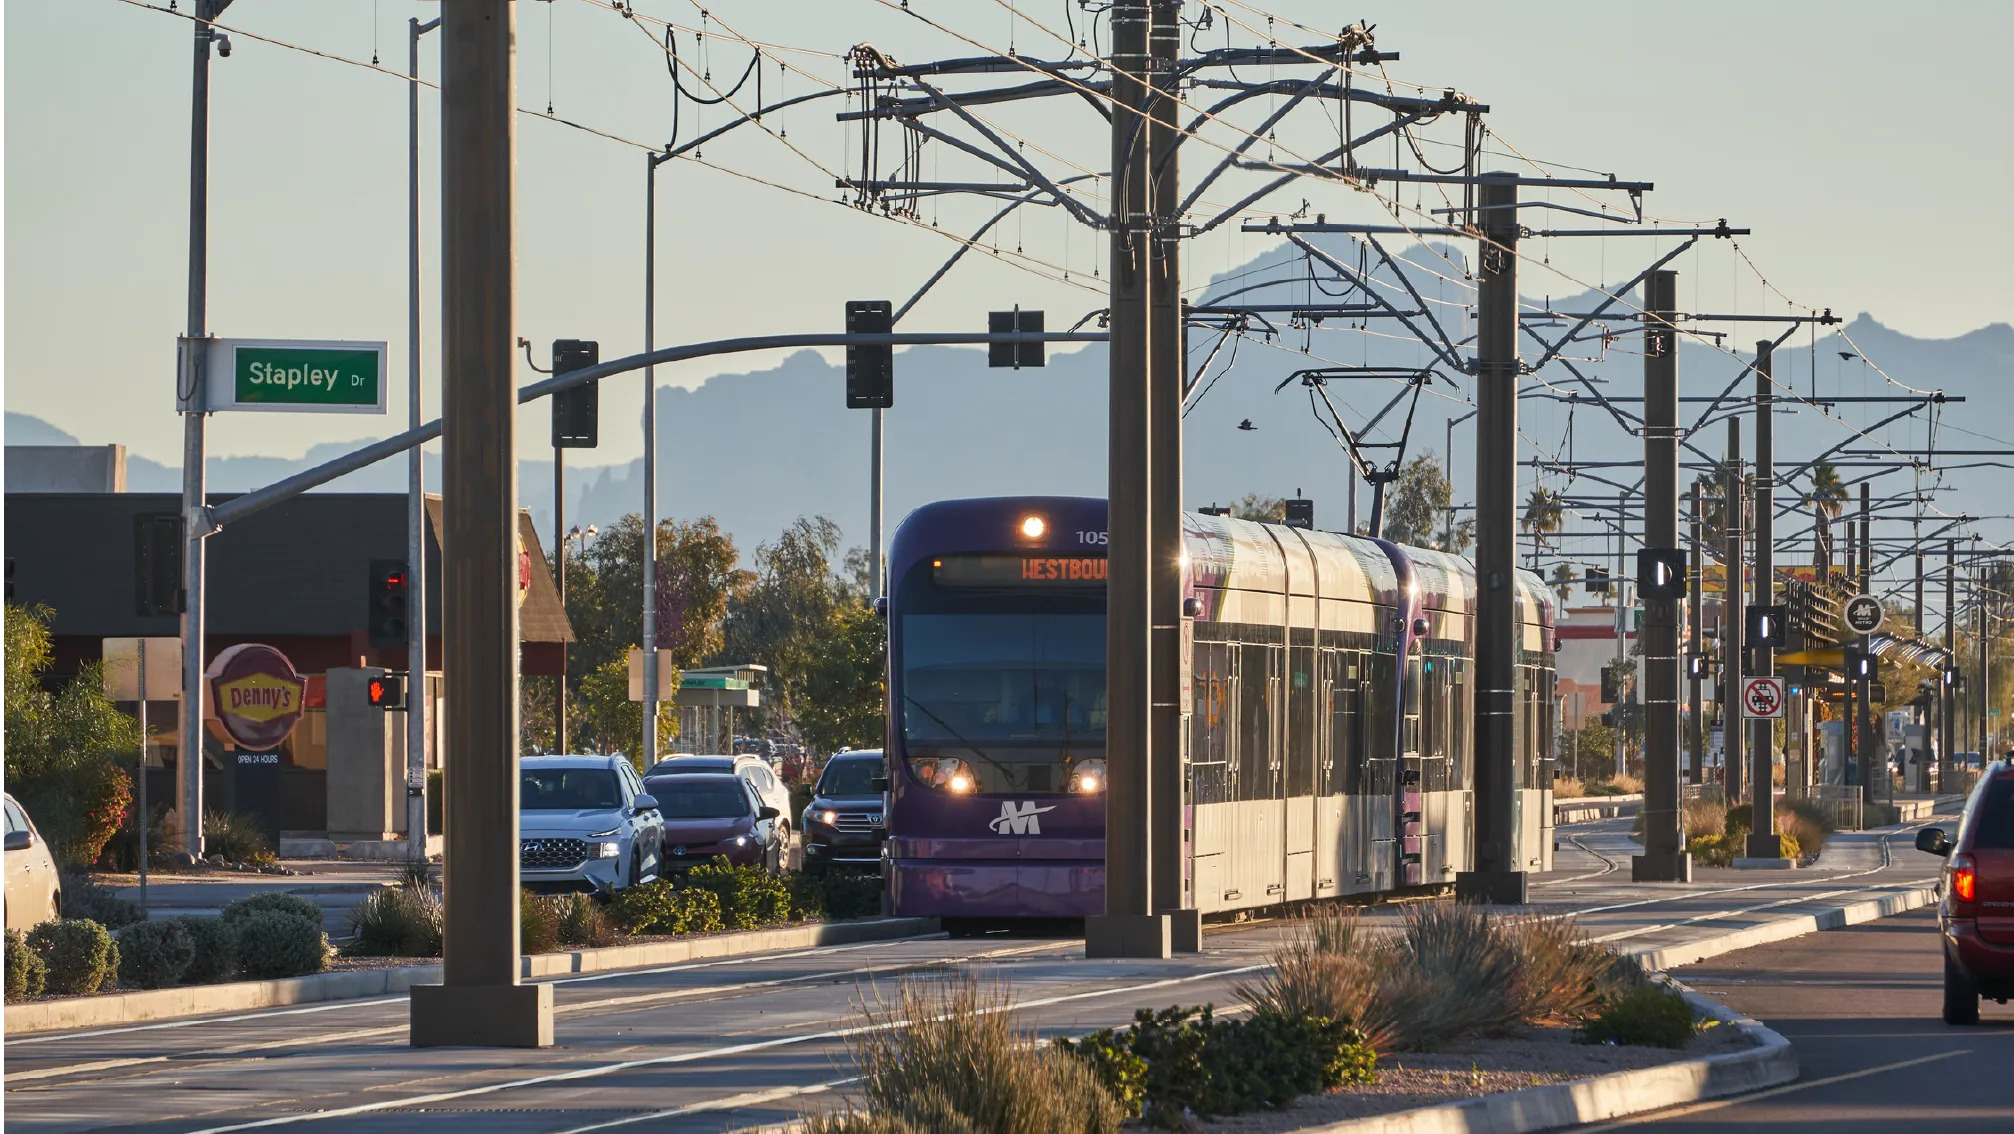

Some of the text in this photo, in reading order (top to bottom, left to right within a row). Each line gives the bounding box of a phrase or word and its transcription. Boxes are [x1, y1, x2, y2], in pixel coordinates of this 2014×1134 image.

[249, 361, 365, 391] Stapley Dr
[230, 685, 291, 710] Denny's
[238, 755, 278, 763] OPEN 24 HOURS
